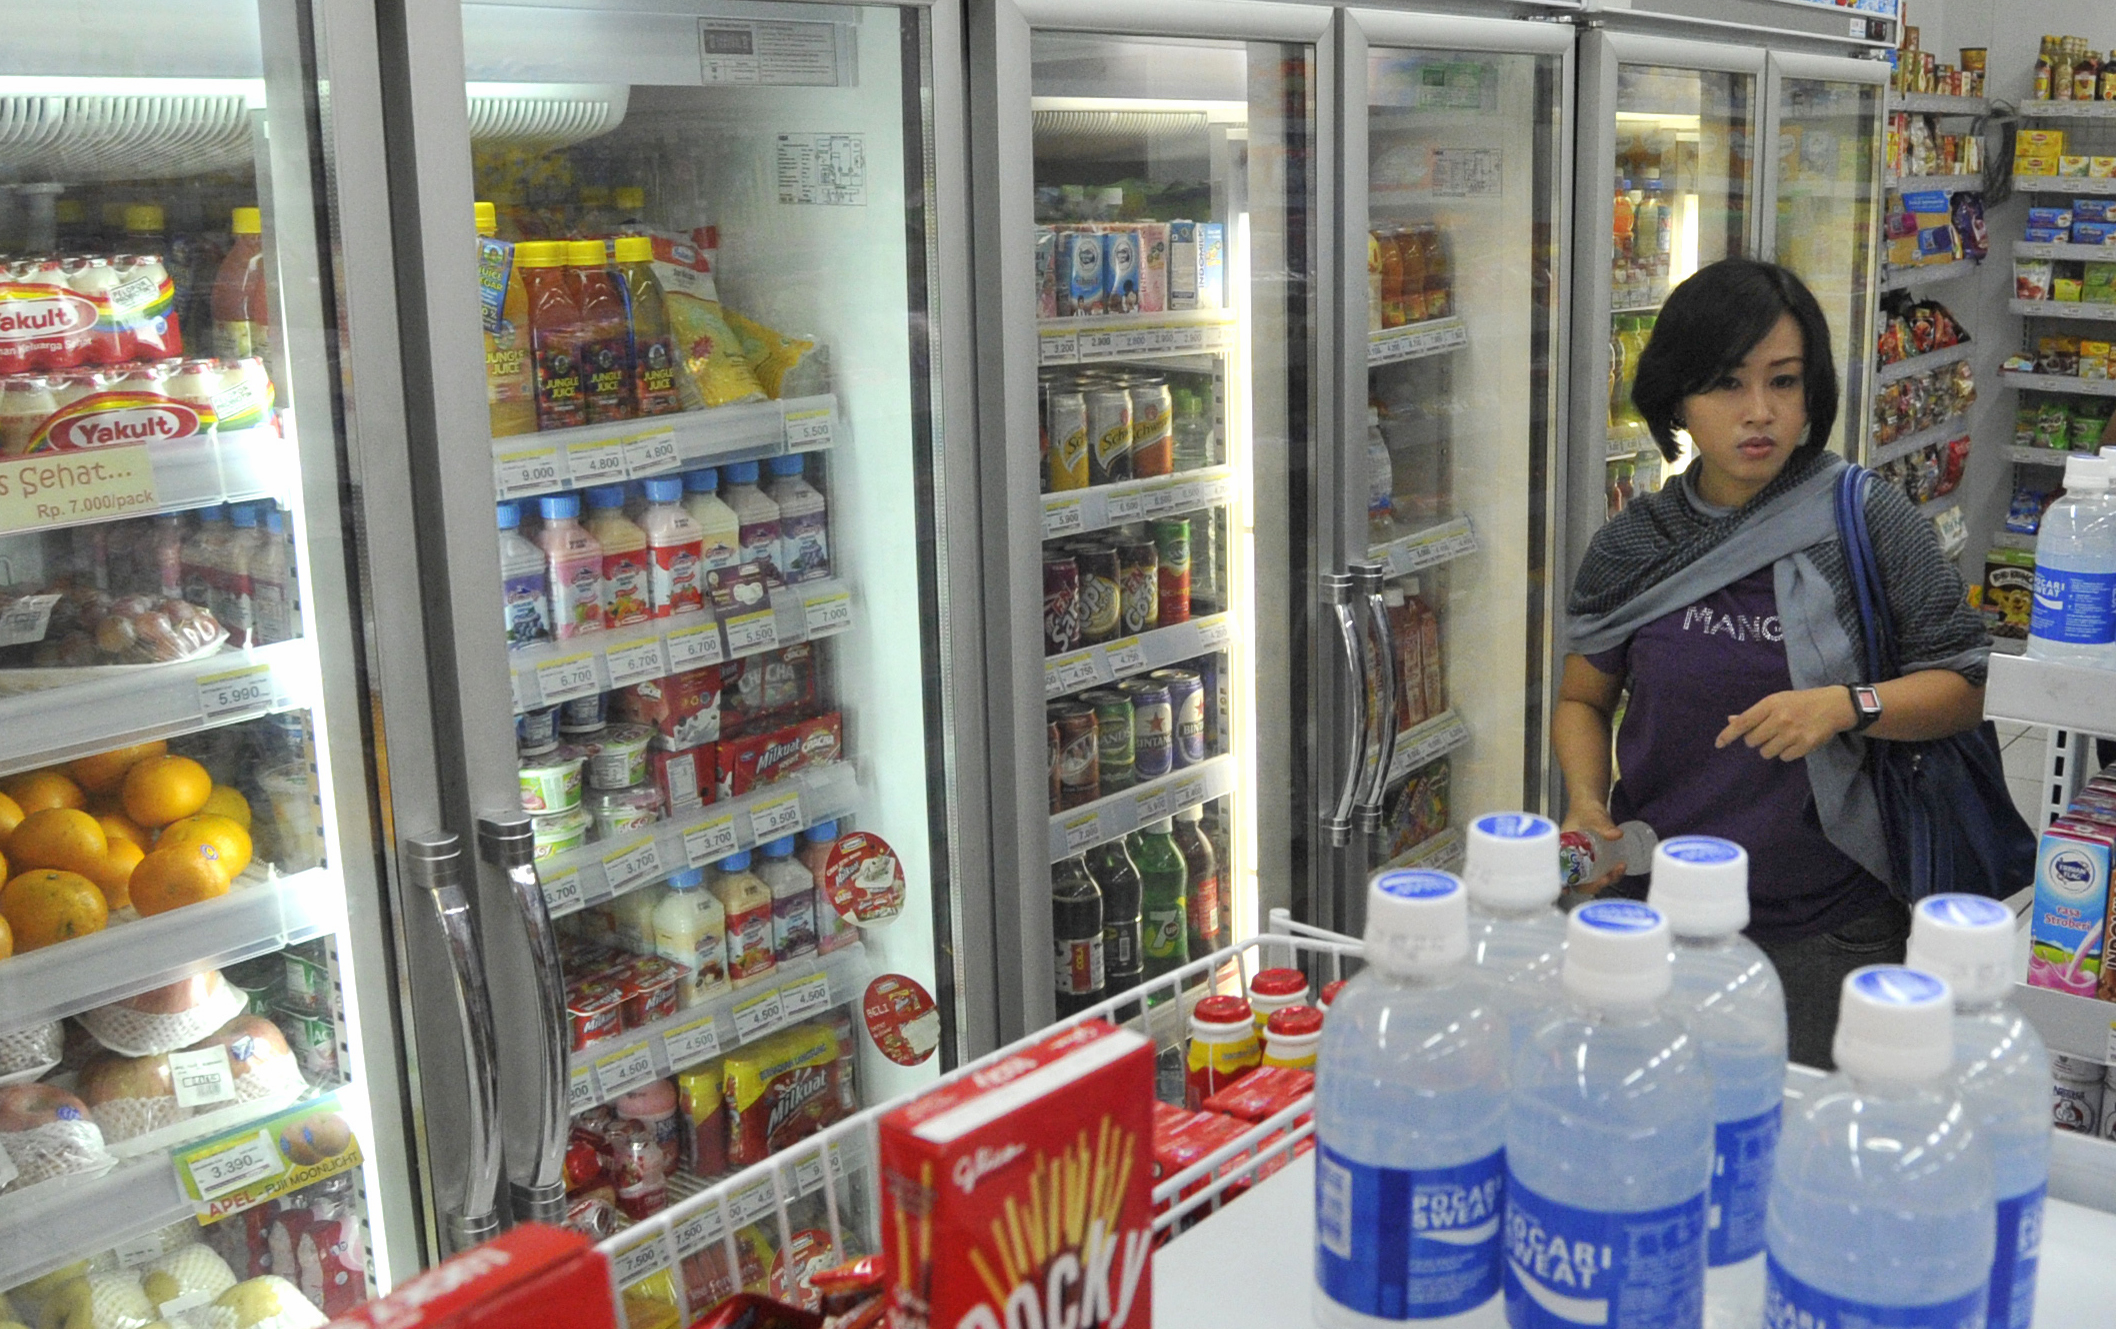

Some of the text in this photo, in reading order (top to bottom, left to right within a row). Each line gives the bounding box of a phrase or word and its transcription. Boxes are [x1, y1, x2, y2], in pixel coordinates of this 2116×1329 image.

[0, 308, 72, 332] akult
[77, 411, 174, 444] Yakult
[588, 456, 620, 471] 4.800
[19, 462, 132, 498] Sehat...
[521, 466, 555, 481] 9.000
[37, 490, 154, 519] Rp. 7.000/pack
[822, 608, 848, 622] 7.000
[746, 628, 773, 642] 5.500
[688, 640, 717, 656] 6.700
[627, 653, 659, 670] 6.700
[560, 669, 592, 686] 6.700
[218, 686, 260, 706] 5.990
[756, 738, 801, 775] Milkuat
[769, 809, 796, 827] 9.500
[703, 831, 732, 849] 3.700
[625, 853, 656, 875] 3.700
[2057, 906, 2081, 918] rasa
[1150, 909, 1178, 949] 7 UP
[2044, 913, 2092, 931] Stroberi
[753, 1005, 780, 1024] 4.500
[686, 1032, 714, 1050] 4.500
[619, 1059, 649, 1078] 4.500
[767, 1069, 827, 1137] Milkuat
[211, 1154, 254, 1179] 3.390
[209, 1189, 256, 1218] APEL
[290, 1150, 359, 1185] MOONLIGHT
[626, 1249, 655, 1269] 7.500
